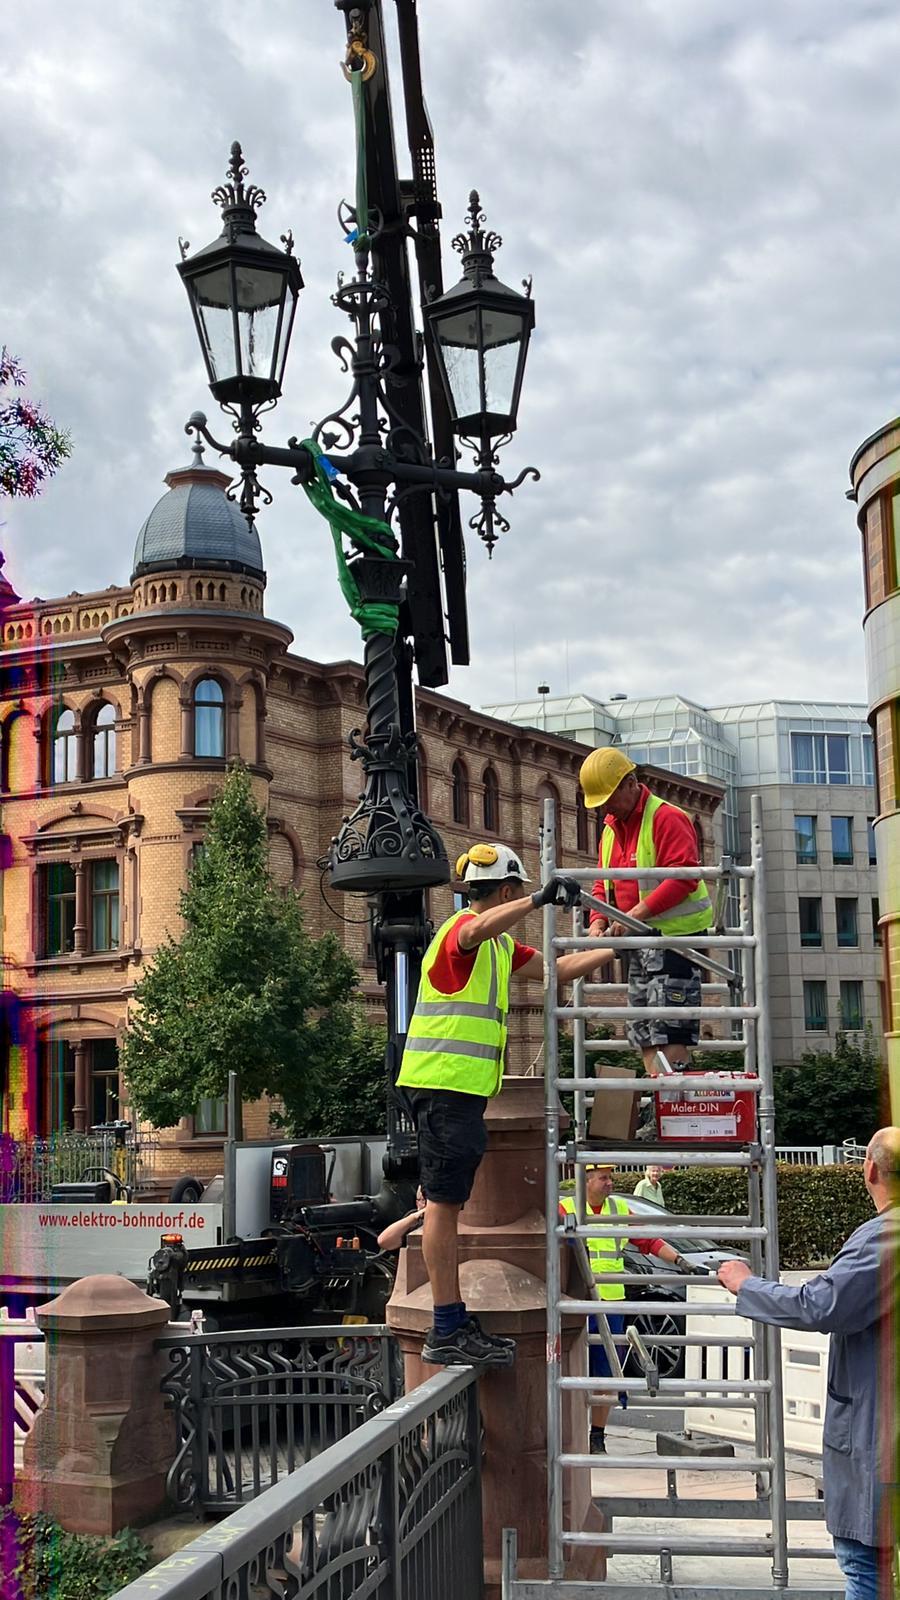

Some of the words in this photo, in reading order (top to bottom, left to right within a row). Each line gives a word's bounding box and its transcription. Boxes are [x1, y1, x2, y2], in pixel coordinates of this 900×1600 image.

[670, 1103, 697, 1113] Maler
[699, 1103, 720, 1113] DIN
[38, 1211, 206, 1229] www.elektro-bohndorf.de
